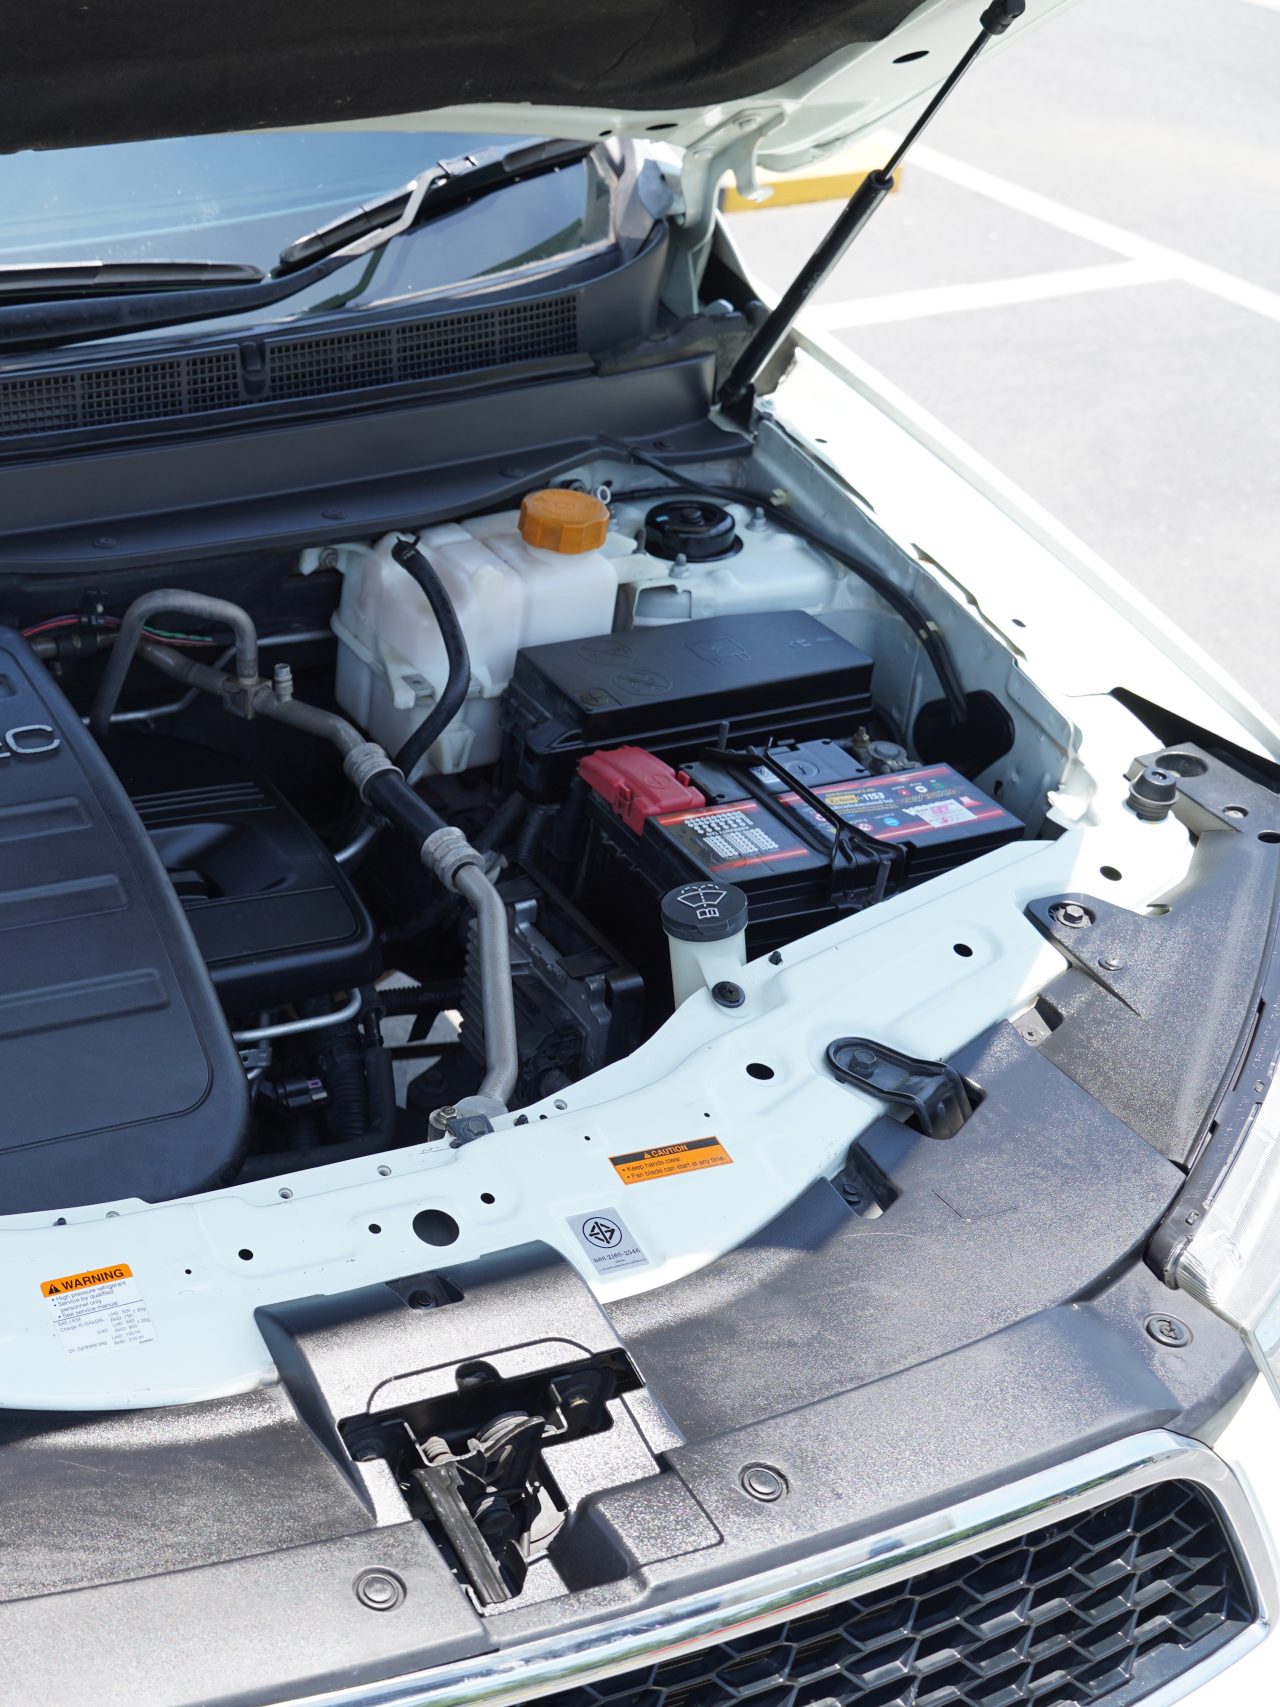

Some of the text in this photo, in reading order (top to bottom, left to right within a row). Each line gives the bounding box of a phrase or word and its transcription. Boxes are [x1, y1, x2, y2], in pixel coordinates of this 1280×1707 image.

[651, 1144, 688, 1158] CAUTION
[626, 1164, 644, 1172] Keep
[645, 1160, 665, 1168] hands
[645, 1168, 663, 1176] blade
[61, 1269, 124, 1290] WARNING
[56, 1281, 127, 1302] High pressure refrigerant
[58, 1299, 80, 1307] Service
[90, 1289, 114, 1299] qualified
[61, 1302, 88, 1313] personnel
[75, 1307, 96, 1315] service
[97, 1301, 119, 1309] manual
